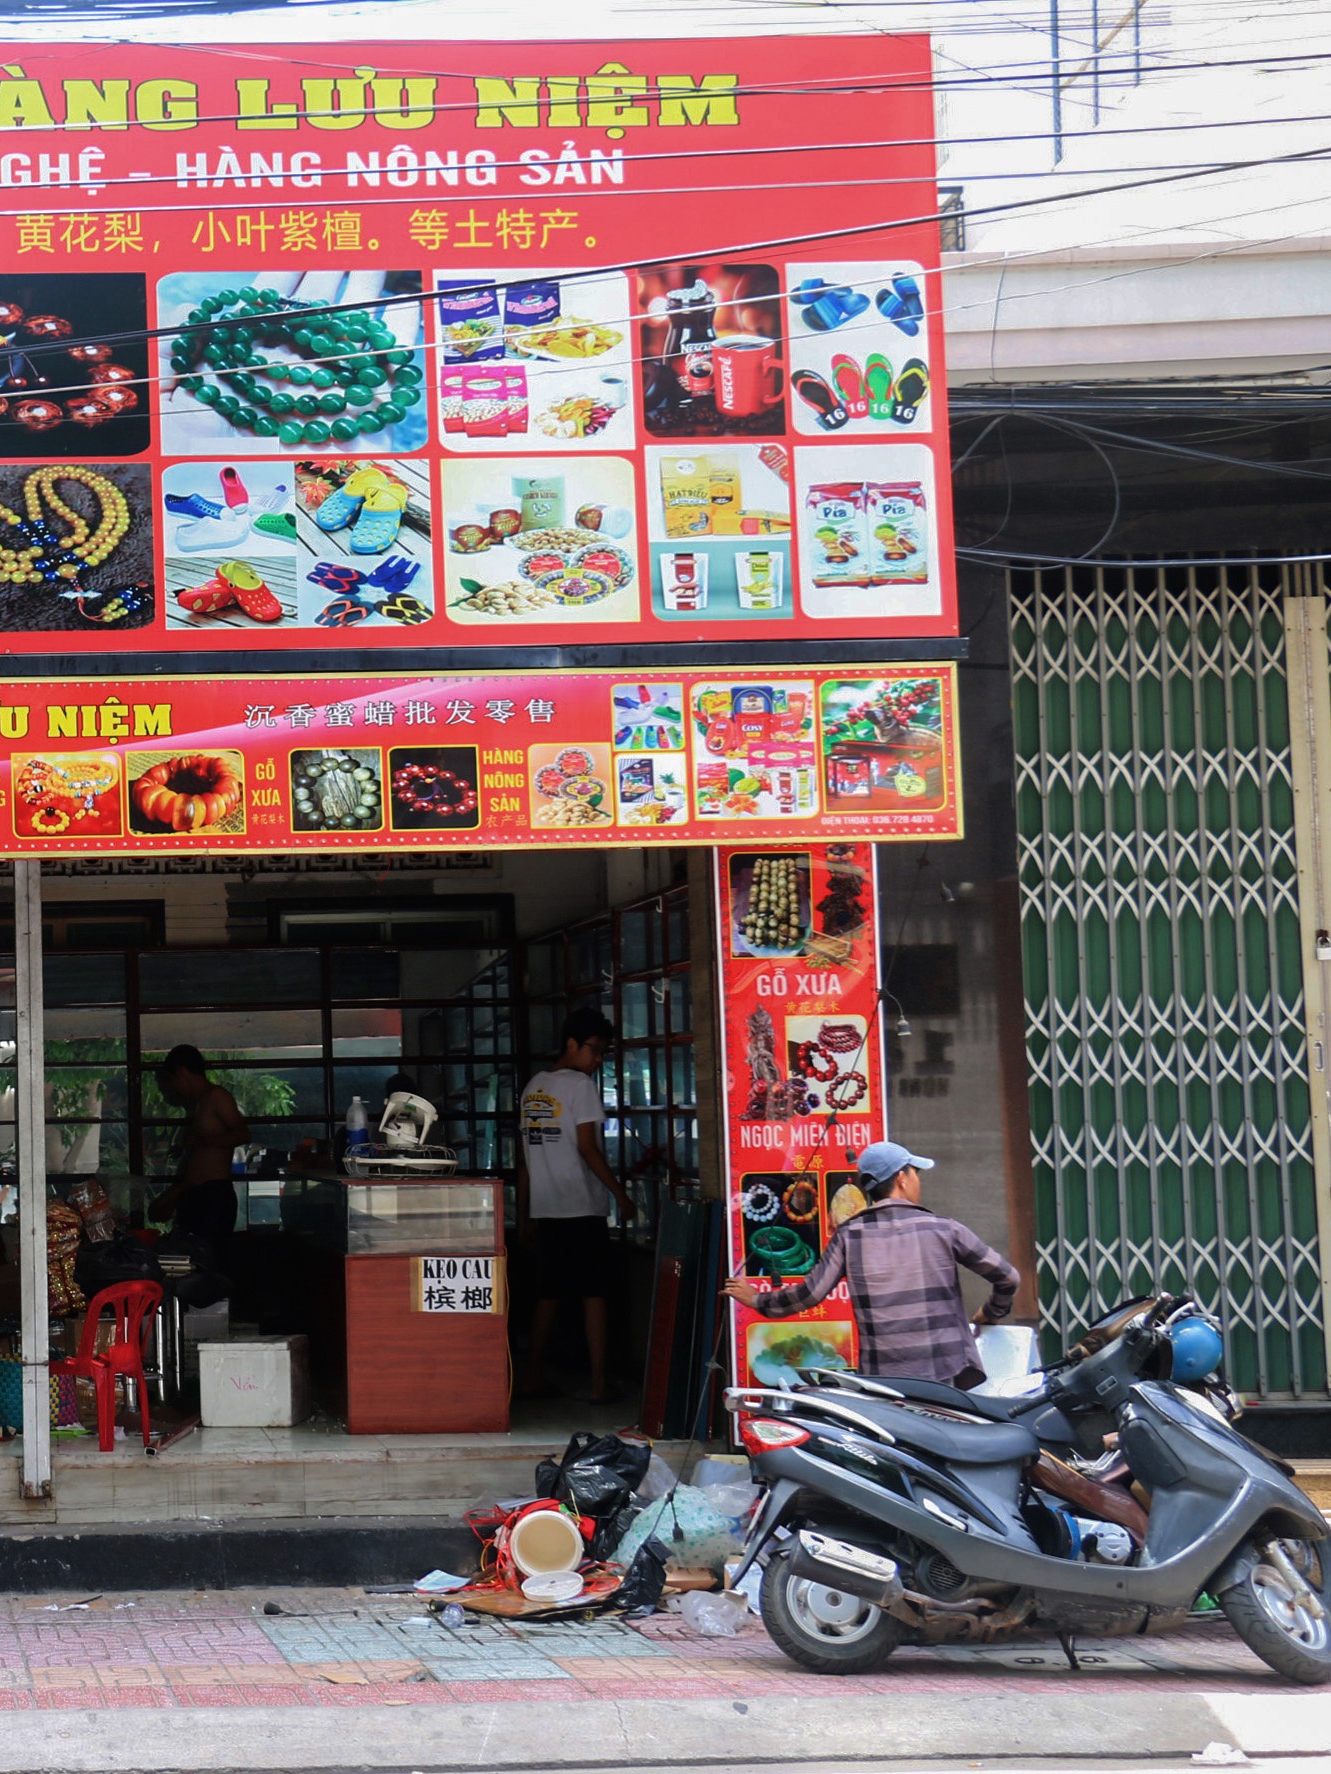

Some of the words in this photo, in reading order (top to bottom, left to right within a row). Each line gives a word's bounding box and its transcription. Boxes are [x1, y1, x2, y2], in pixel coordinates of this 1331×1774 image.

[236, 65, 438, 129] LƯU
[475, 61, 741, 142] NIỆM
[176, 146, 323, 189] HÀNG
[346, 145, 498, 187] NÔNG
[519, 139, 625, 186] SẢN
[825, 408, 845, 425] 16
[847, 401, 866, 414] 16
[872, 403, 889, 414] 16
[895, 405, 914, 420] 16
[47, 696, 173, 745] NIỆM
[244, 698, 556, 729] 沉香蜜蜡批发零售
[483, 748, 524, 766] HÀNG
[255, 757, 276, 780] GỖ
[484, 769, 525, 789] NÔNG
[251, 788, 282, 807] XƯA
[489, 792, 521, 813] SẢN
[485, 813, 528, 829] 农产品
[756, 968, 788, 996] GỖ
[795, 972, 842, 995] XƯA
[740, 1124, 784, 1151] NGỌC
[835, 1122, 871, 1148] ĐIỆN
[422, 1259, 457, 1284] KẸO
[462, 1259, 493, 1280] CAU
[423, 1286, 493, 1311] 槟榔
